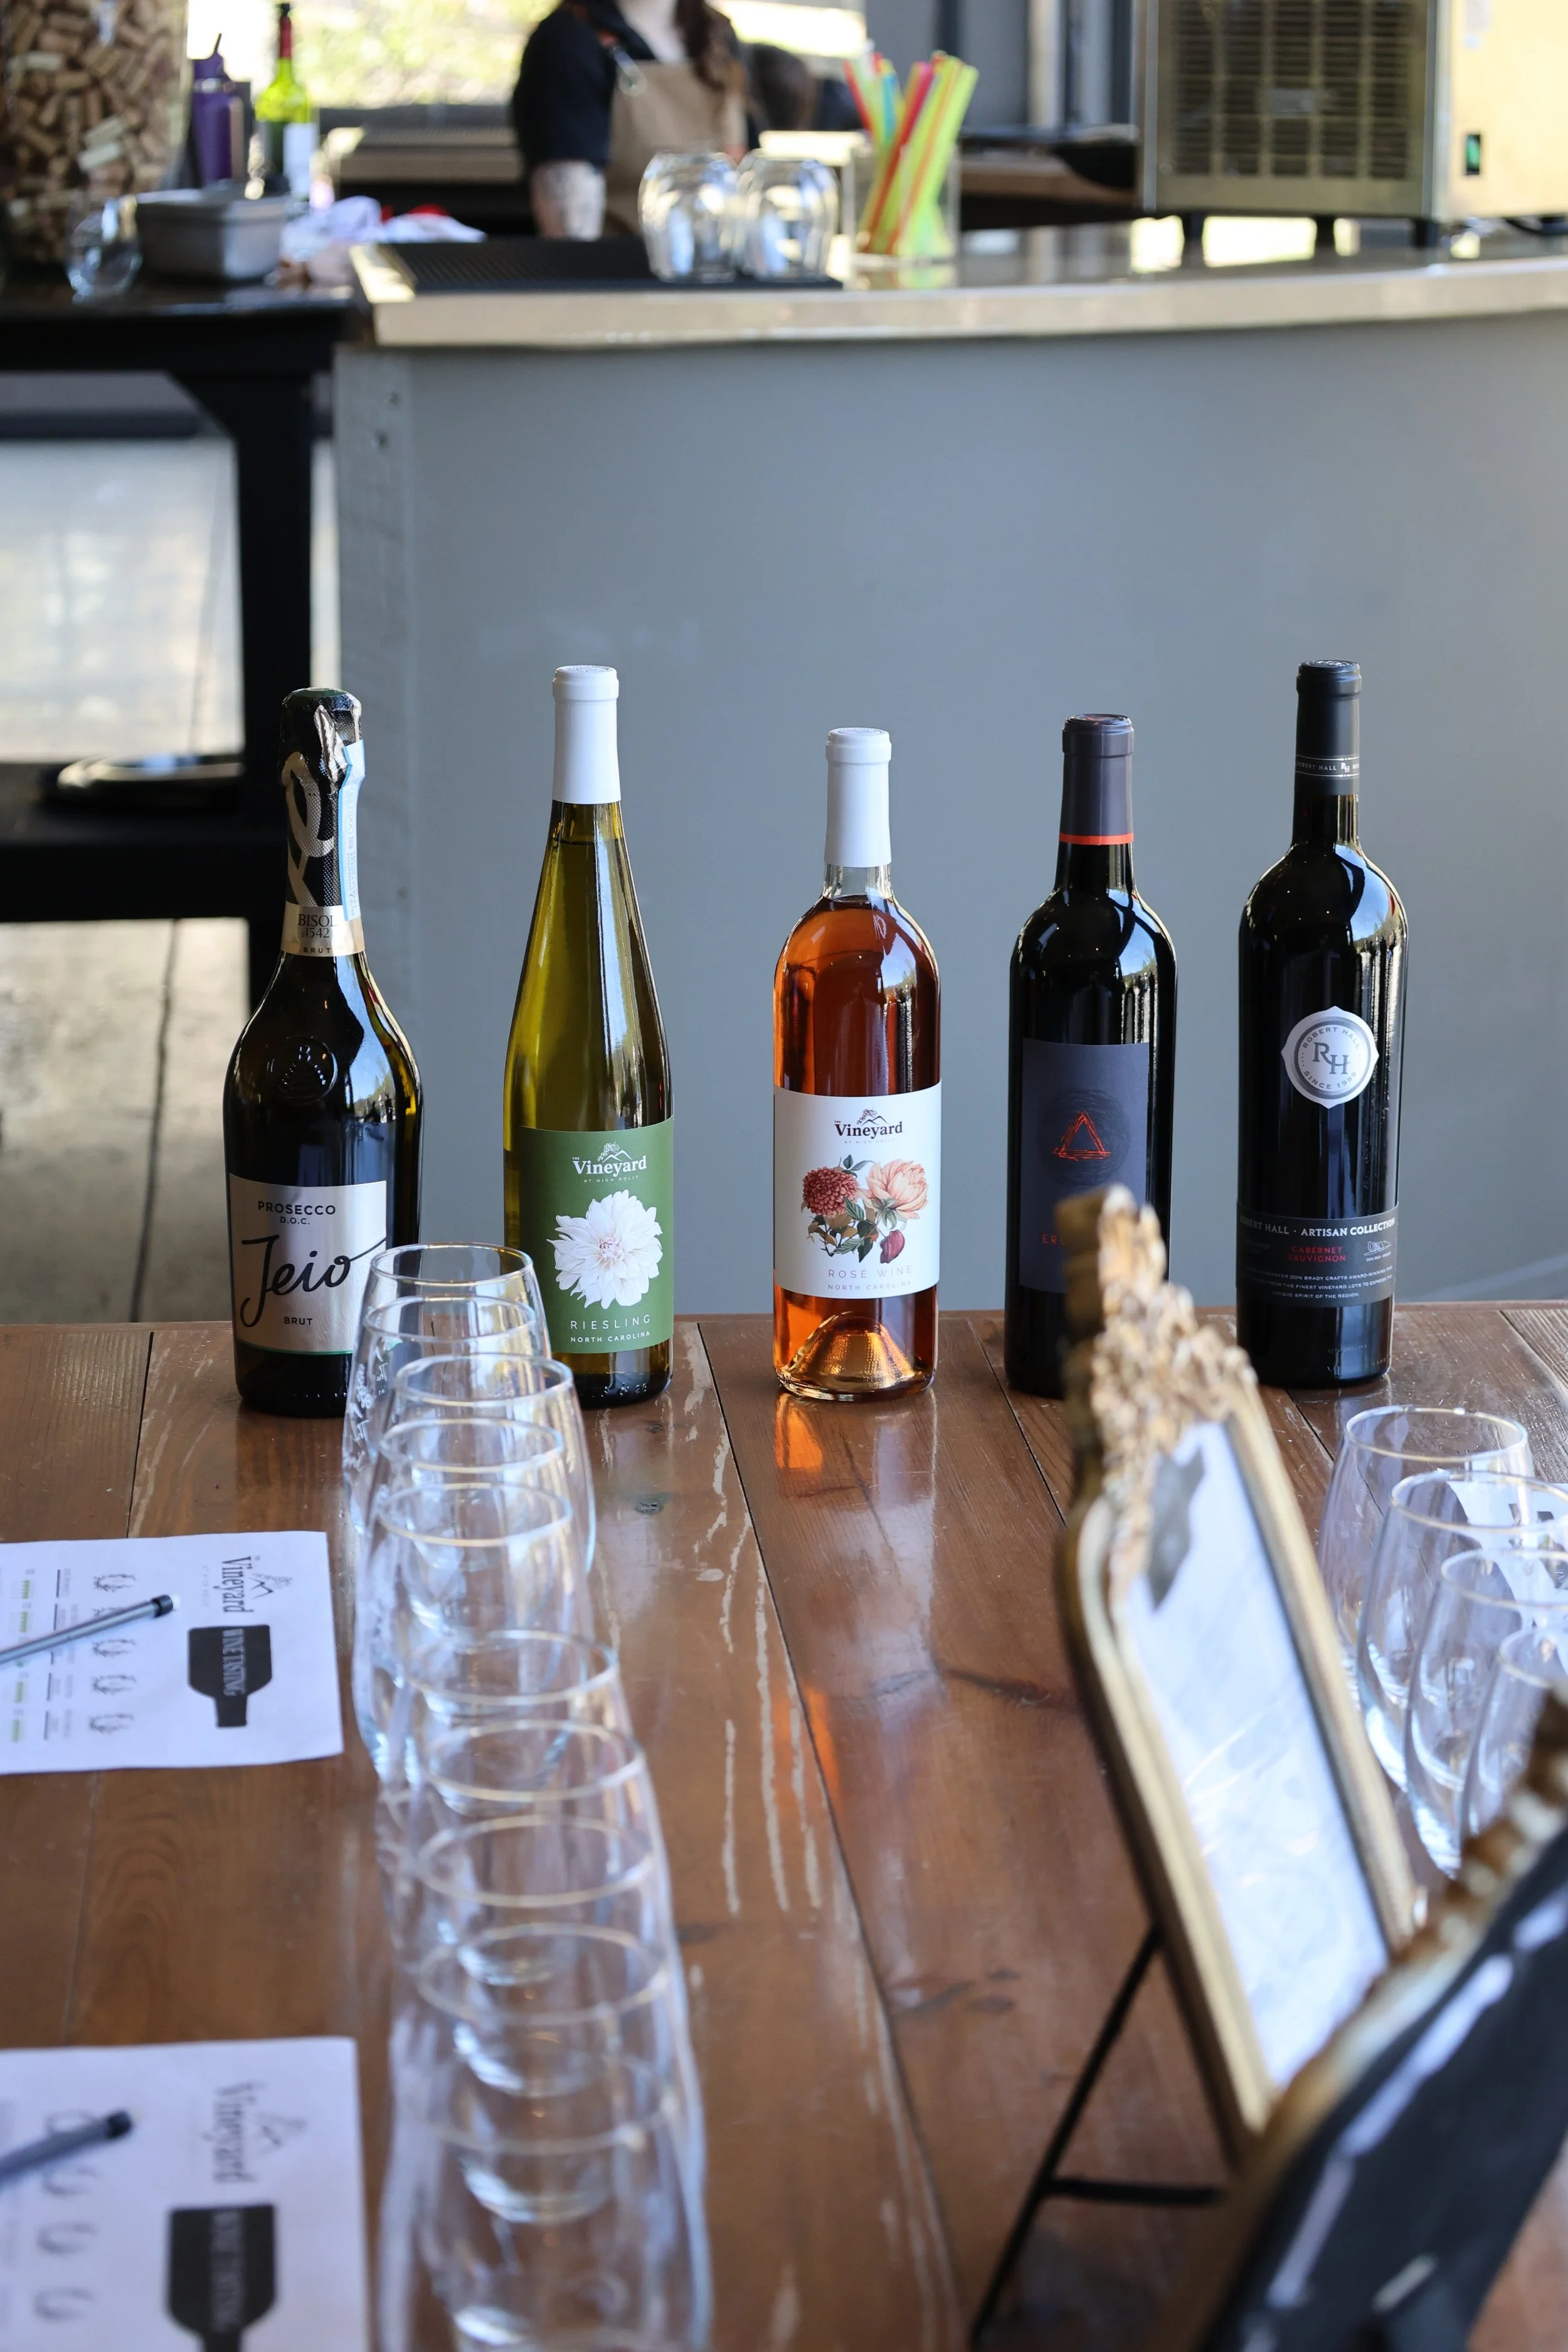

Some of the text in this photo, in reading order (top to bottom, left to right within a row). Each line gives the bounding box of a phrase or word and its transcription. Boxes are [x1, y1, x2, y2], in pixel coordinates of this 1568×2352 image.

[297, 913, 337, 927] BISOL
[305, 927, 330, 938] 1542
[1303, 1027, 1361, 1050] ROBERT HALL
[1312, 1042, 1350, 1074] RH
[1303, 1070, 1357, 1089] SINCE 1999
[834, 1121, 903, 1140] Vineyard
[572, 1155, 647, 1177] Vineyard
[258, 1200, 336, 1216] PROSECCO
[280, 1216, 310, 1225] D.O.C.
[1265, 1222, 1289, 1234] HALL
[1301, 1227, 1348, 1237] ARTISAN
[1350, 1217, 1396, 1236] COLLECTION
[1291, 1246, 1343, 1254] CABERNET
[828, 1265, 913, 1278] ROSÉ WINE
[240, 1234, 386, 1328] Jeio
[866, 1281, 911, 1290] CAROLINA
[284, 1316, 313, 1325] BRUT
[570, 1314, 650, 1330] RIESLING
[607, 1331, 650, 1342] CAROLINA
[212, 1555, 254, 1613] Vineyard
